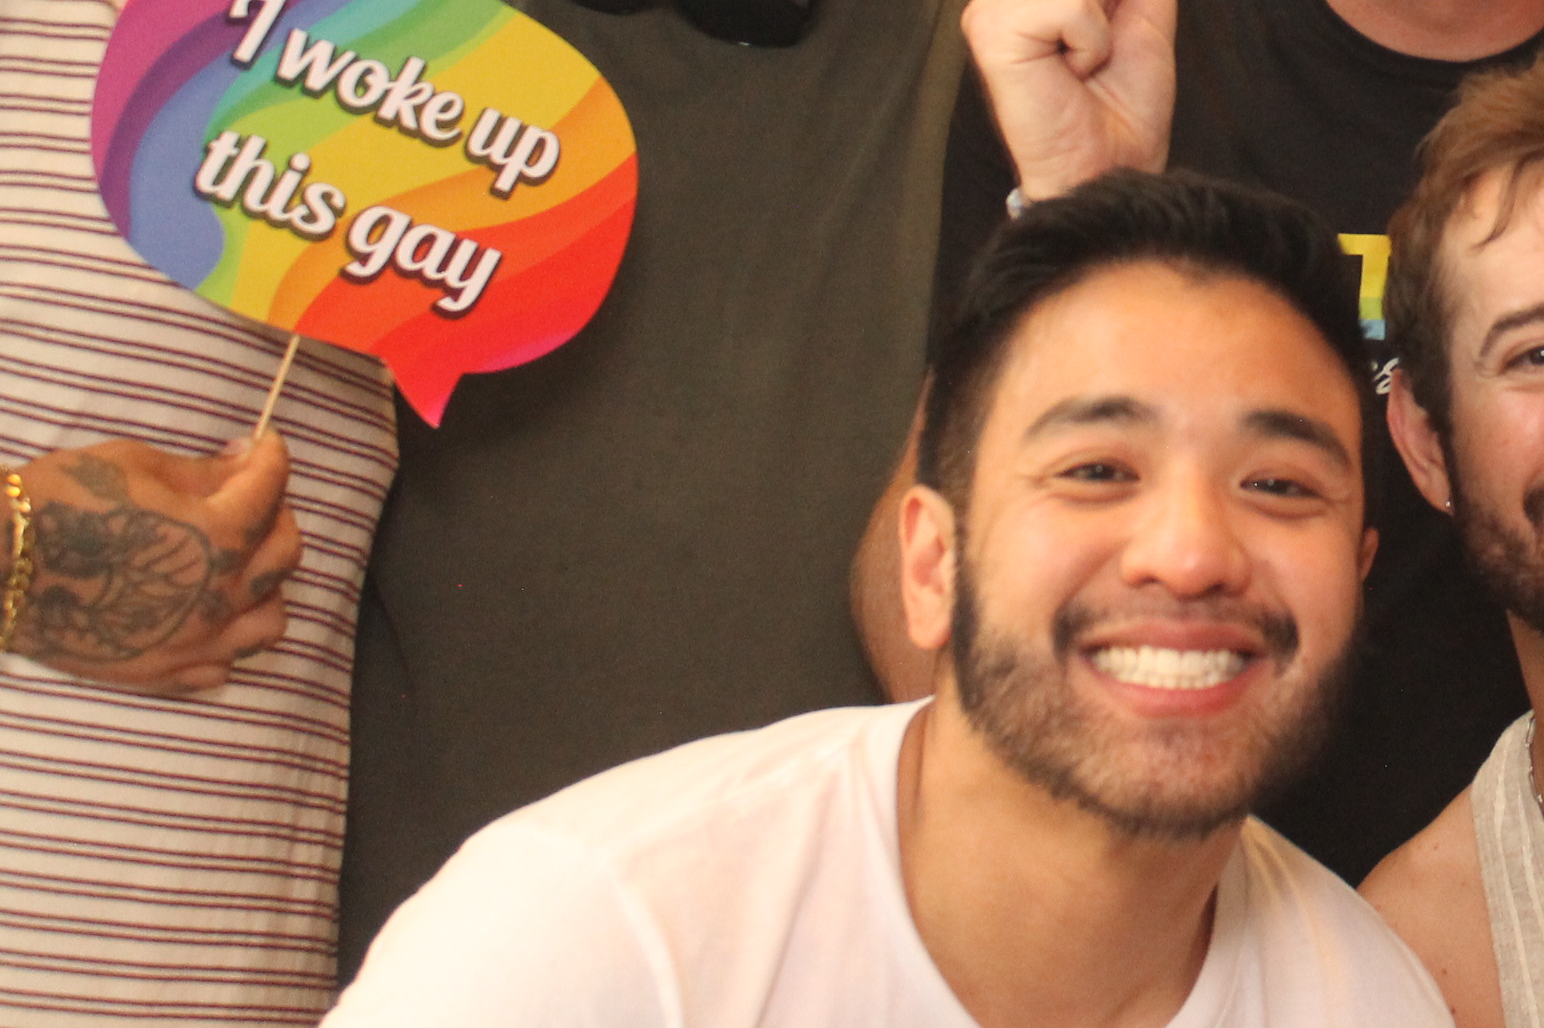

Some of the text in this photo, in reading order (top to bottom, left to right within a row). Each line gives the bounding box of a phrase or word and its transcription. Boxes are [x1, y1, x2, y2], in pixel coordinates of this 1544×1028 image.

[276, 27, 464, 142] woke
[466, 107, 560, 196] up
[195, 130, 503, 314] this gay
